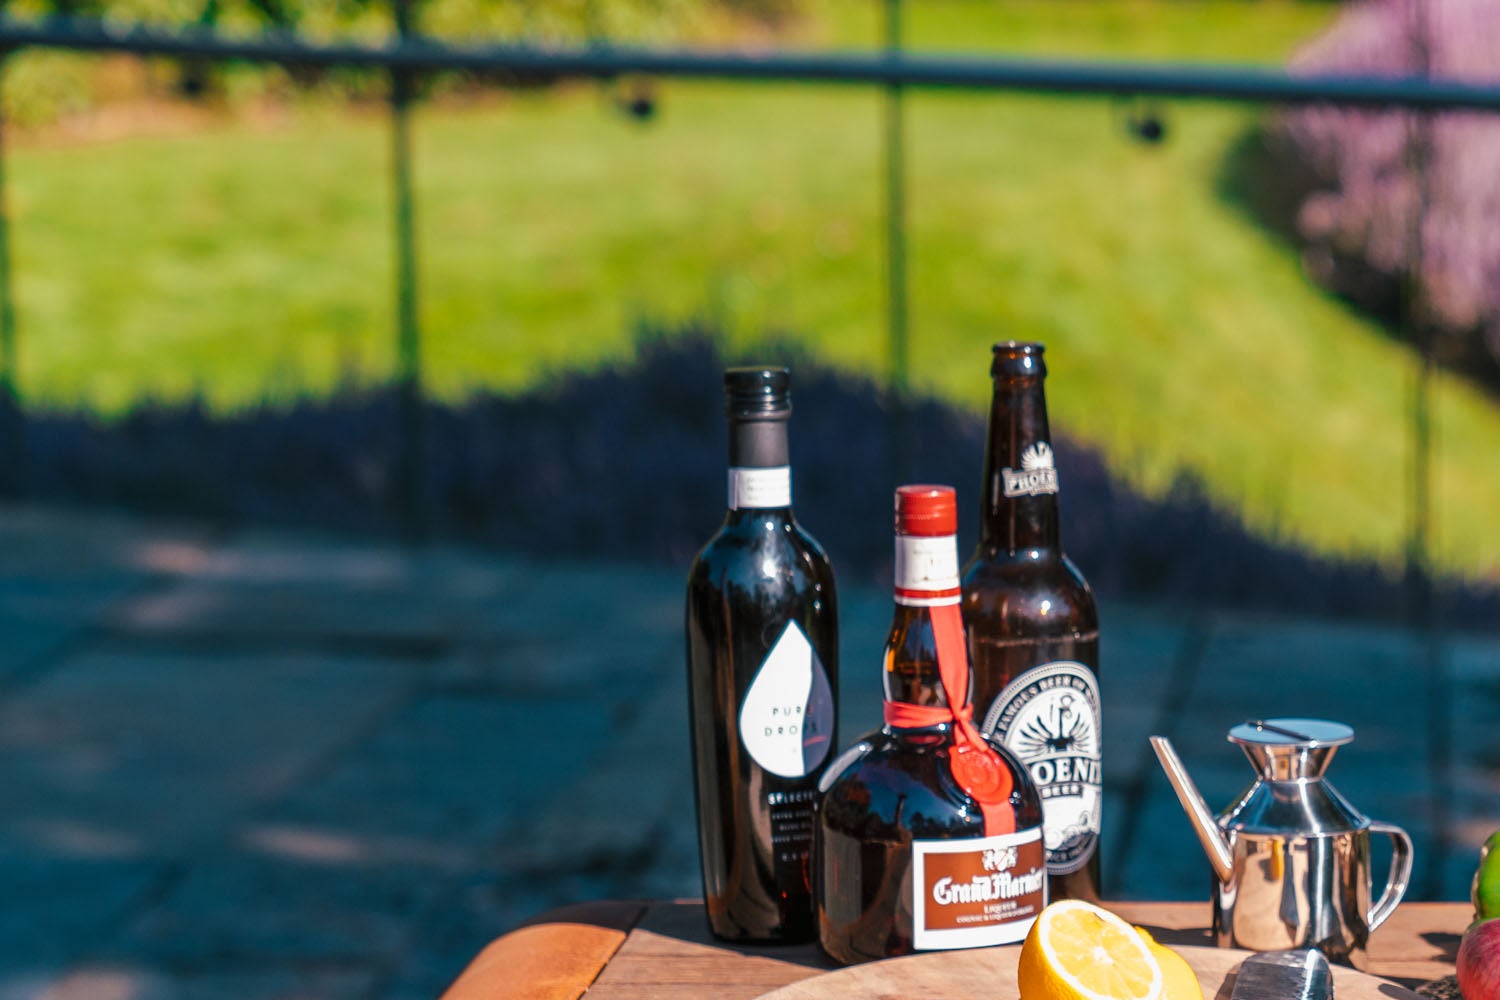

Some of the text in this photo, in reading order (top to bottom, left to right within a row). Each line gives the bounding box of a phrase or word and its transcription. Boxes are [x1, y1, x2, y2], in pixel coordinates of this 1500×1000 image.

[997, 685, 1039, 731] FAMOUS
[1039, 675, 1072, 691] BEER
[764, 724, 818, 737] DRO
